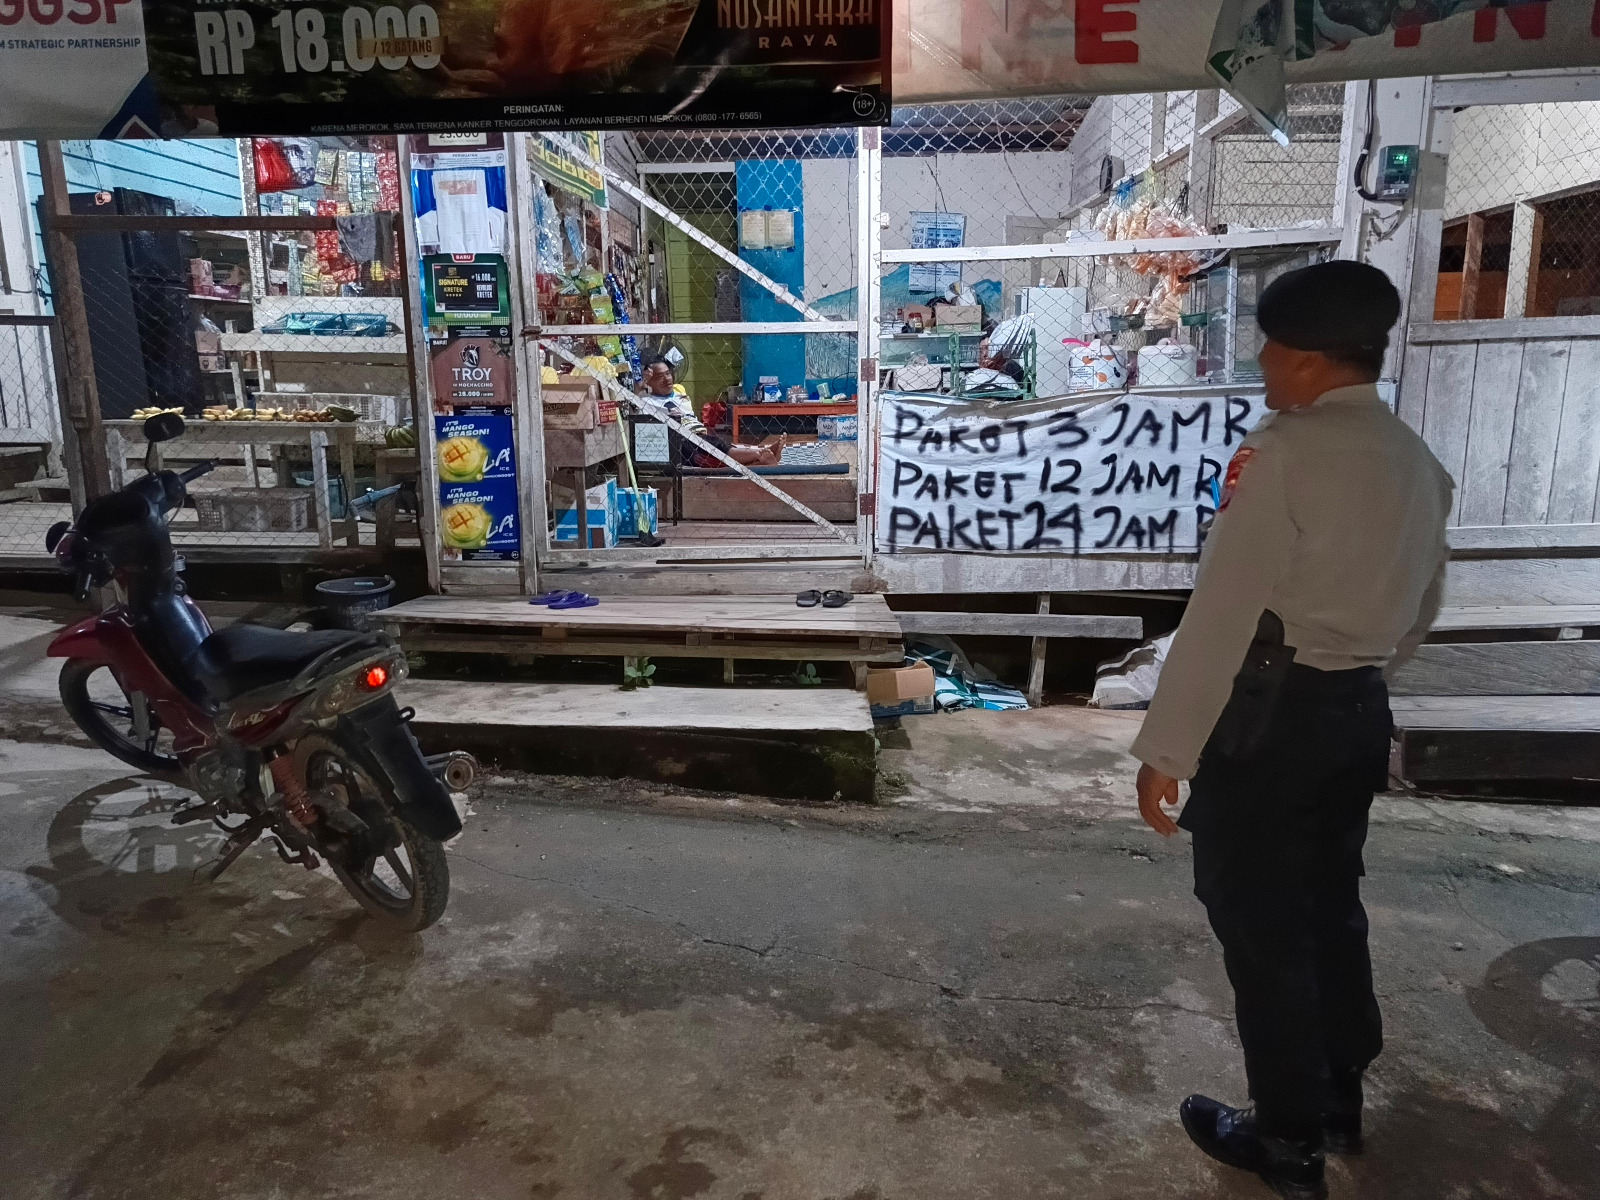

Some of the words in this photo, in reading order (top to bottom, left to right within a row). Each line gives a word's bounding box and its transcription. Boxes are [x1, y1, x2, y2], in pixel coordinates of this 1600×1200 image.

[717, 0, 873, 29] NUSANTARA
[8, 39, 65, 49] STRATEGIC
[67, 38, 141, 48] PARTNERSHIP
[194, 10, 255, 75] RP
[271, 4, 441, 72] 18.000
[758, 34, 838, 48] RAYA
[381, 41, 392, 55] 12
[394, 40, 432, 54] BATANG
[503, 104, 565, 114] PERINGATAN:
[856, 99, 873, 109] 18+
[310, 124, 346, 133] KARENA
[393, 122, 415, 131] SAYA
[416, 121, 456, 130] TERKENA
[457, 120, 492, 129] KANKER
[494, 117, 560, 128] TENGGOROKAN
[564, 115, 603, 125] LAYANAN
[604, 115, 648, 124] BERHENTI
[650, 114, 694, 123] MEROKOK
[438, 278, 469, 286] SIGNATURE
[451, 367, 492, 381] TROY
[442, 423, 475, 432] MANGO
[448, 428, 490, 438] SEASON!
[1047, 411, 1090, 449] 3
[1100, 402, 1209, 452] JAM
[893, 457, 1026, 503] PAKET
[1039, 456, 1083, 495] 12
[1091, 453, 1181, 498] JAM
[446, 490, 479, 499] MANGO
[452, 495, 494, 505] SEASON!
[888, 503, 1021, 554] PAKET
[1023, 501, 1084, 557] 24
[1093, 505, 1178, 553] JAM
